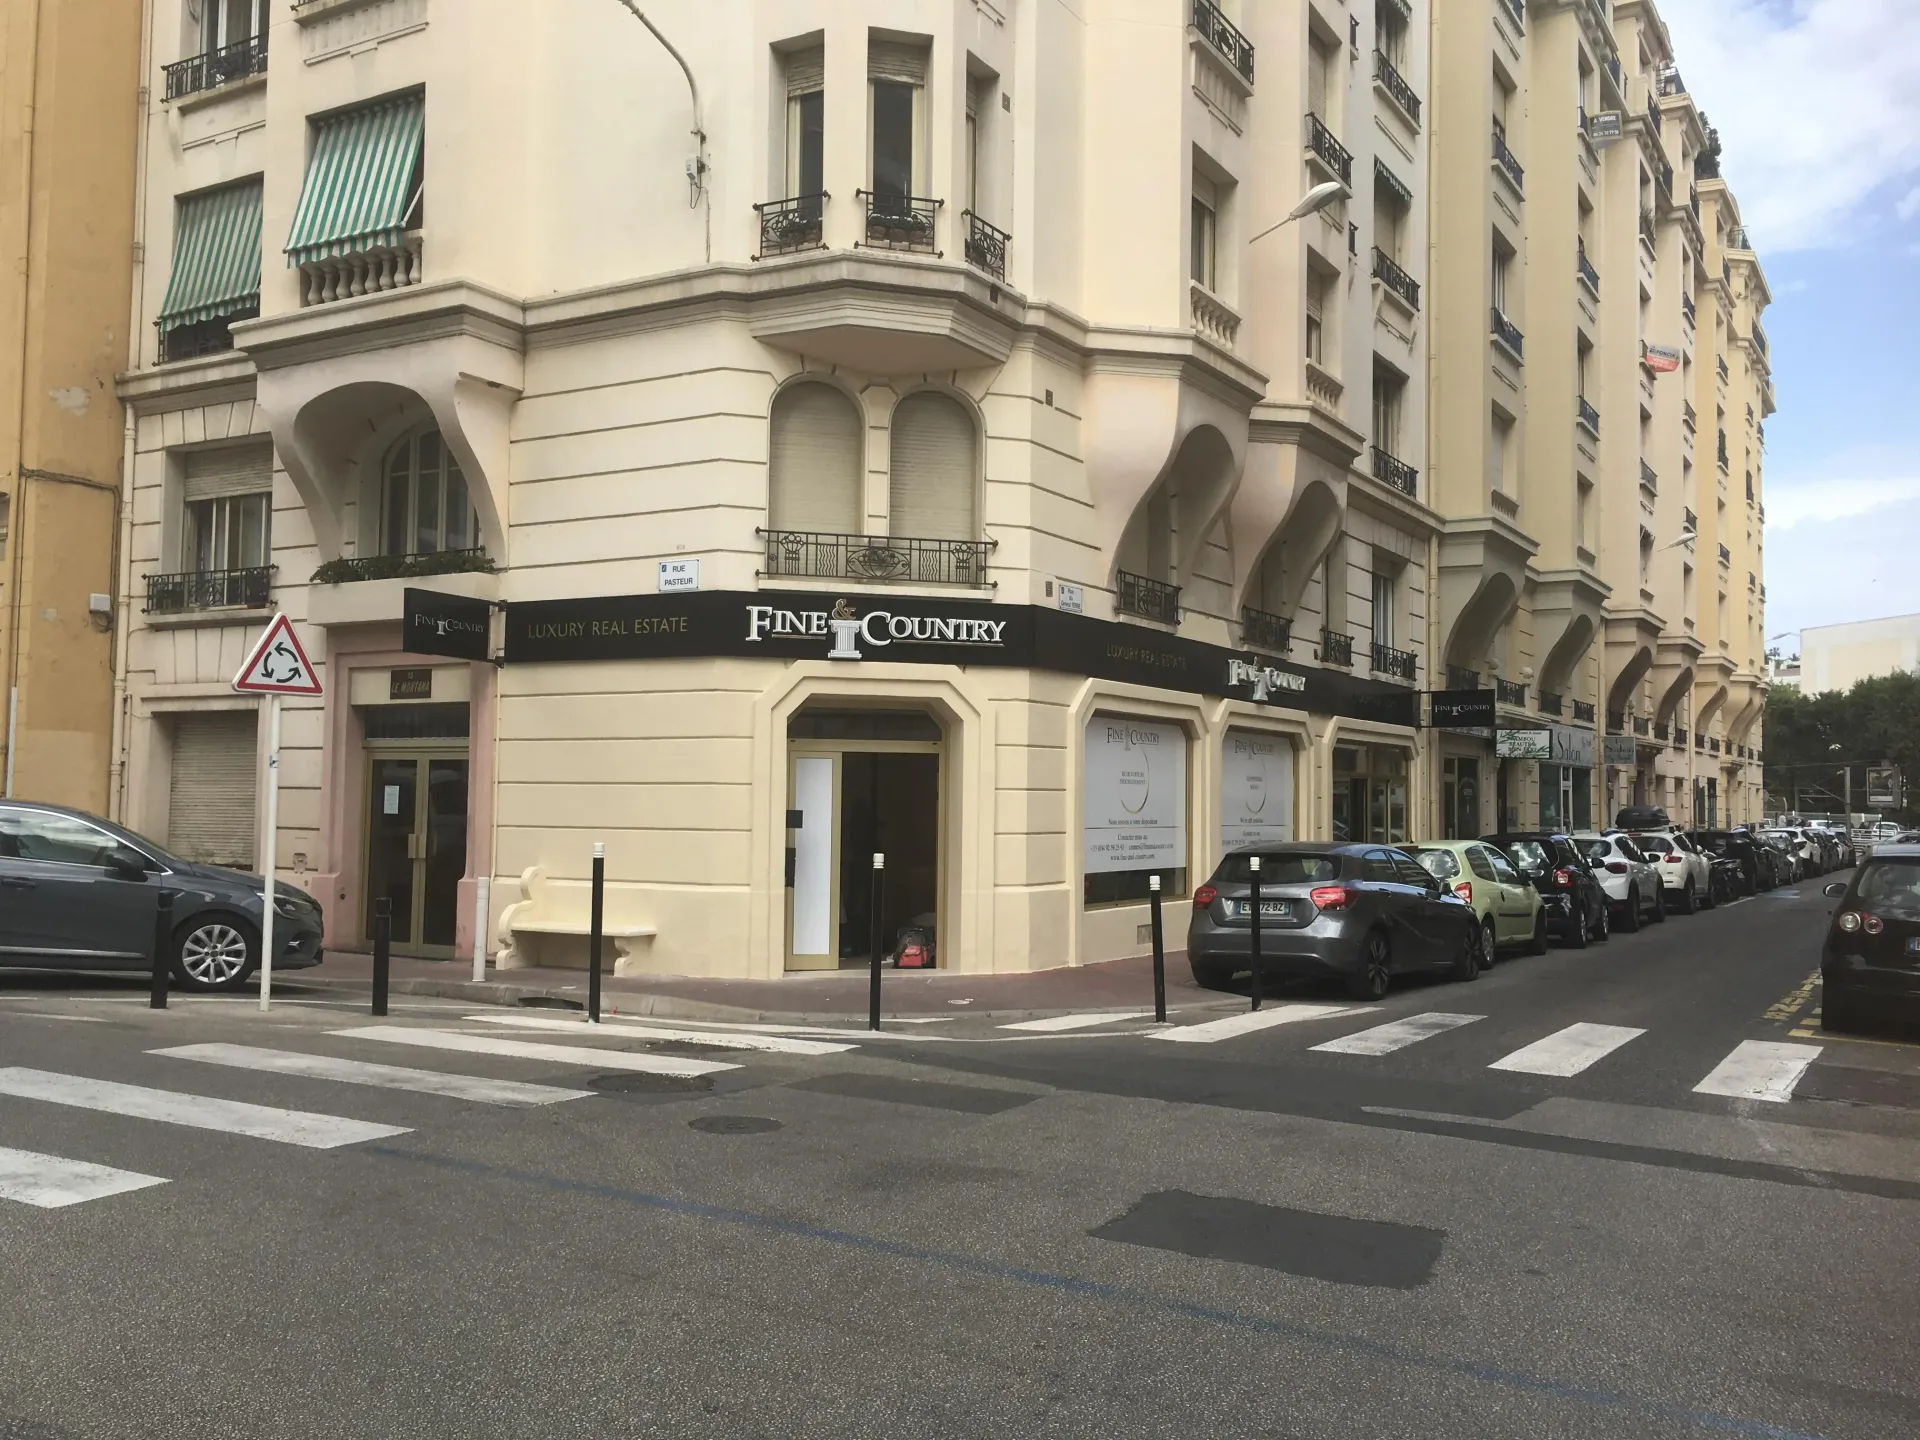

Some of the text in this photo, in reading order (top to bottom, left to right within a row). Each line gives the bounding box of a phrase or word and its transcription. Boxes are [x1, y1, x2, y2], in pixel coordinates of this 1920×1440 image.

[672, 564, 686, 572] RUE
[664, 578, 693, 586] PASTEUR
[415, 613, 485, 633] FINE COUNTRY
[528, 617, 688, 638] LUXURY REAL ESTATE
[746, 598, 1007, 647] FINE & COUNTRY
[1106, 643, 1138, 661] LUXURY
[1161, 653, 1188, 671] ESTATE
[1228, 658, 1258, 686] FINE
[1264, 666, 1306, 692] COUNTRY
[391, 681, 398, 694] LE
[1458, 704, 1490, 712] COUNTRY
[1106, 727, 1160, 746] FINE COUNTRY
[1234, 740, 1248, 754] FINE
